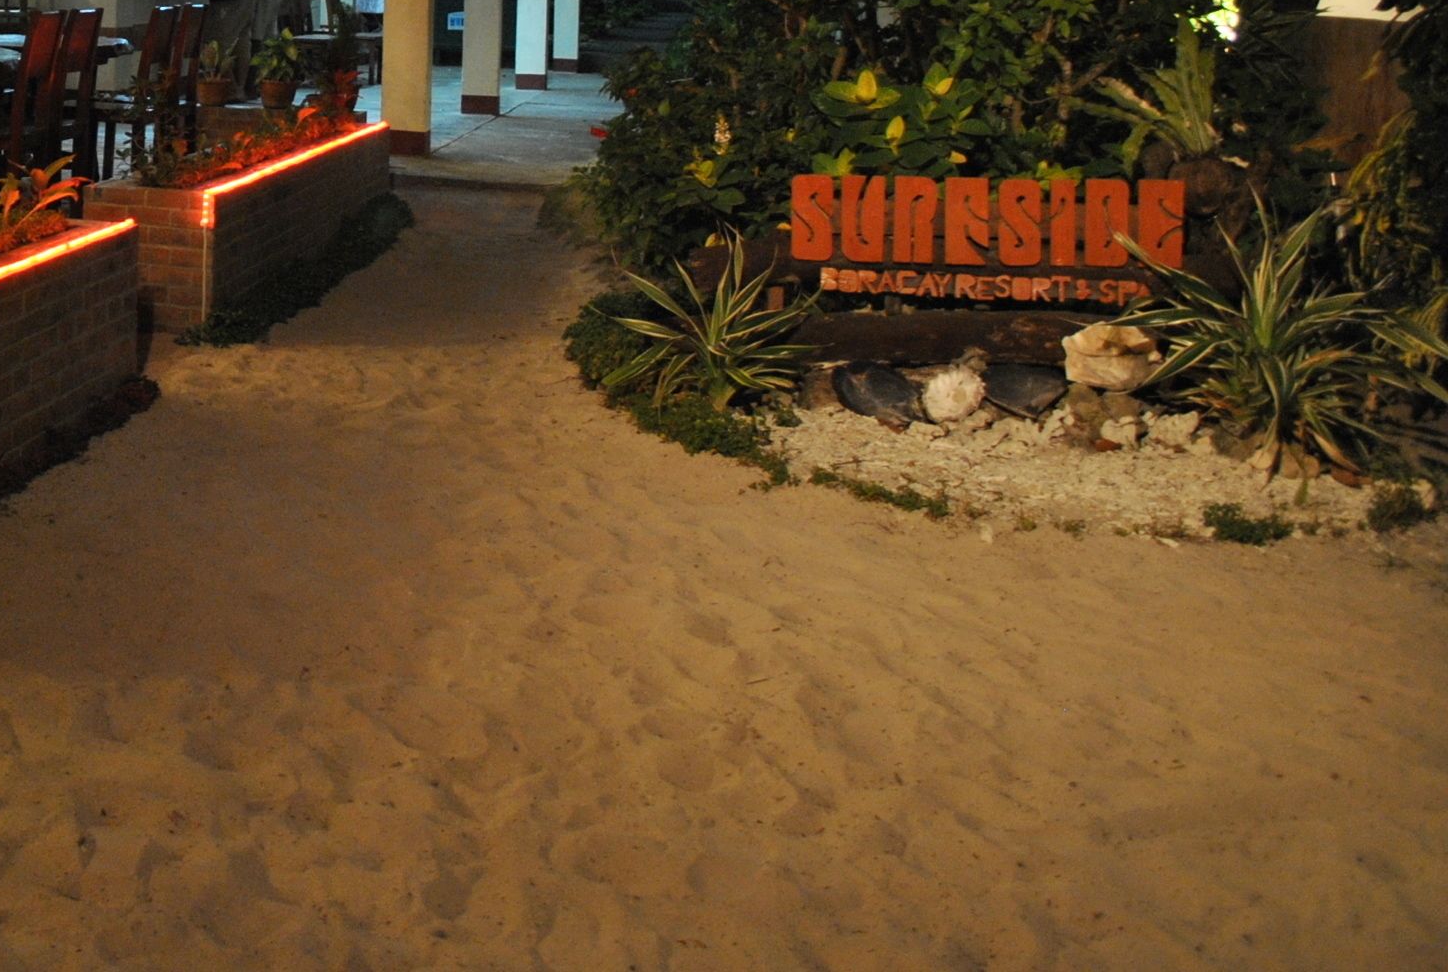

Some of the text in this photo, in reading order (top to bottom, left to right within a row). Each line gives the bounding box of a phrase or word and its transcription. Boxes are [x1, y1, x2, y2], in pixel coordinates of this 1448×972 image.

[790, 174, 1187, 269] SURFSIDE
[819, 267, 1152, 308] BORACAY RESORT & SPA
